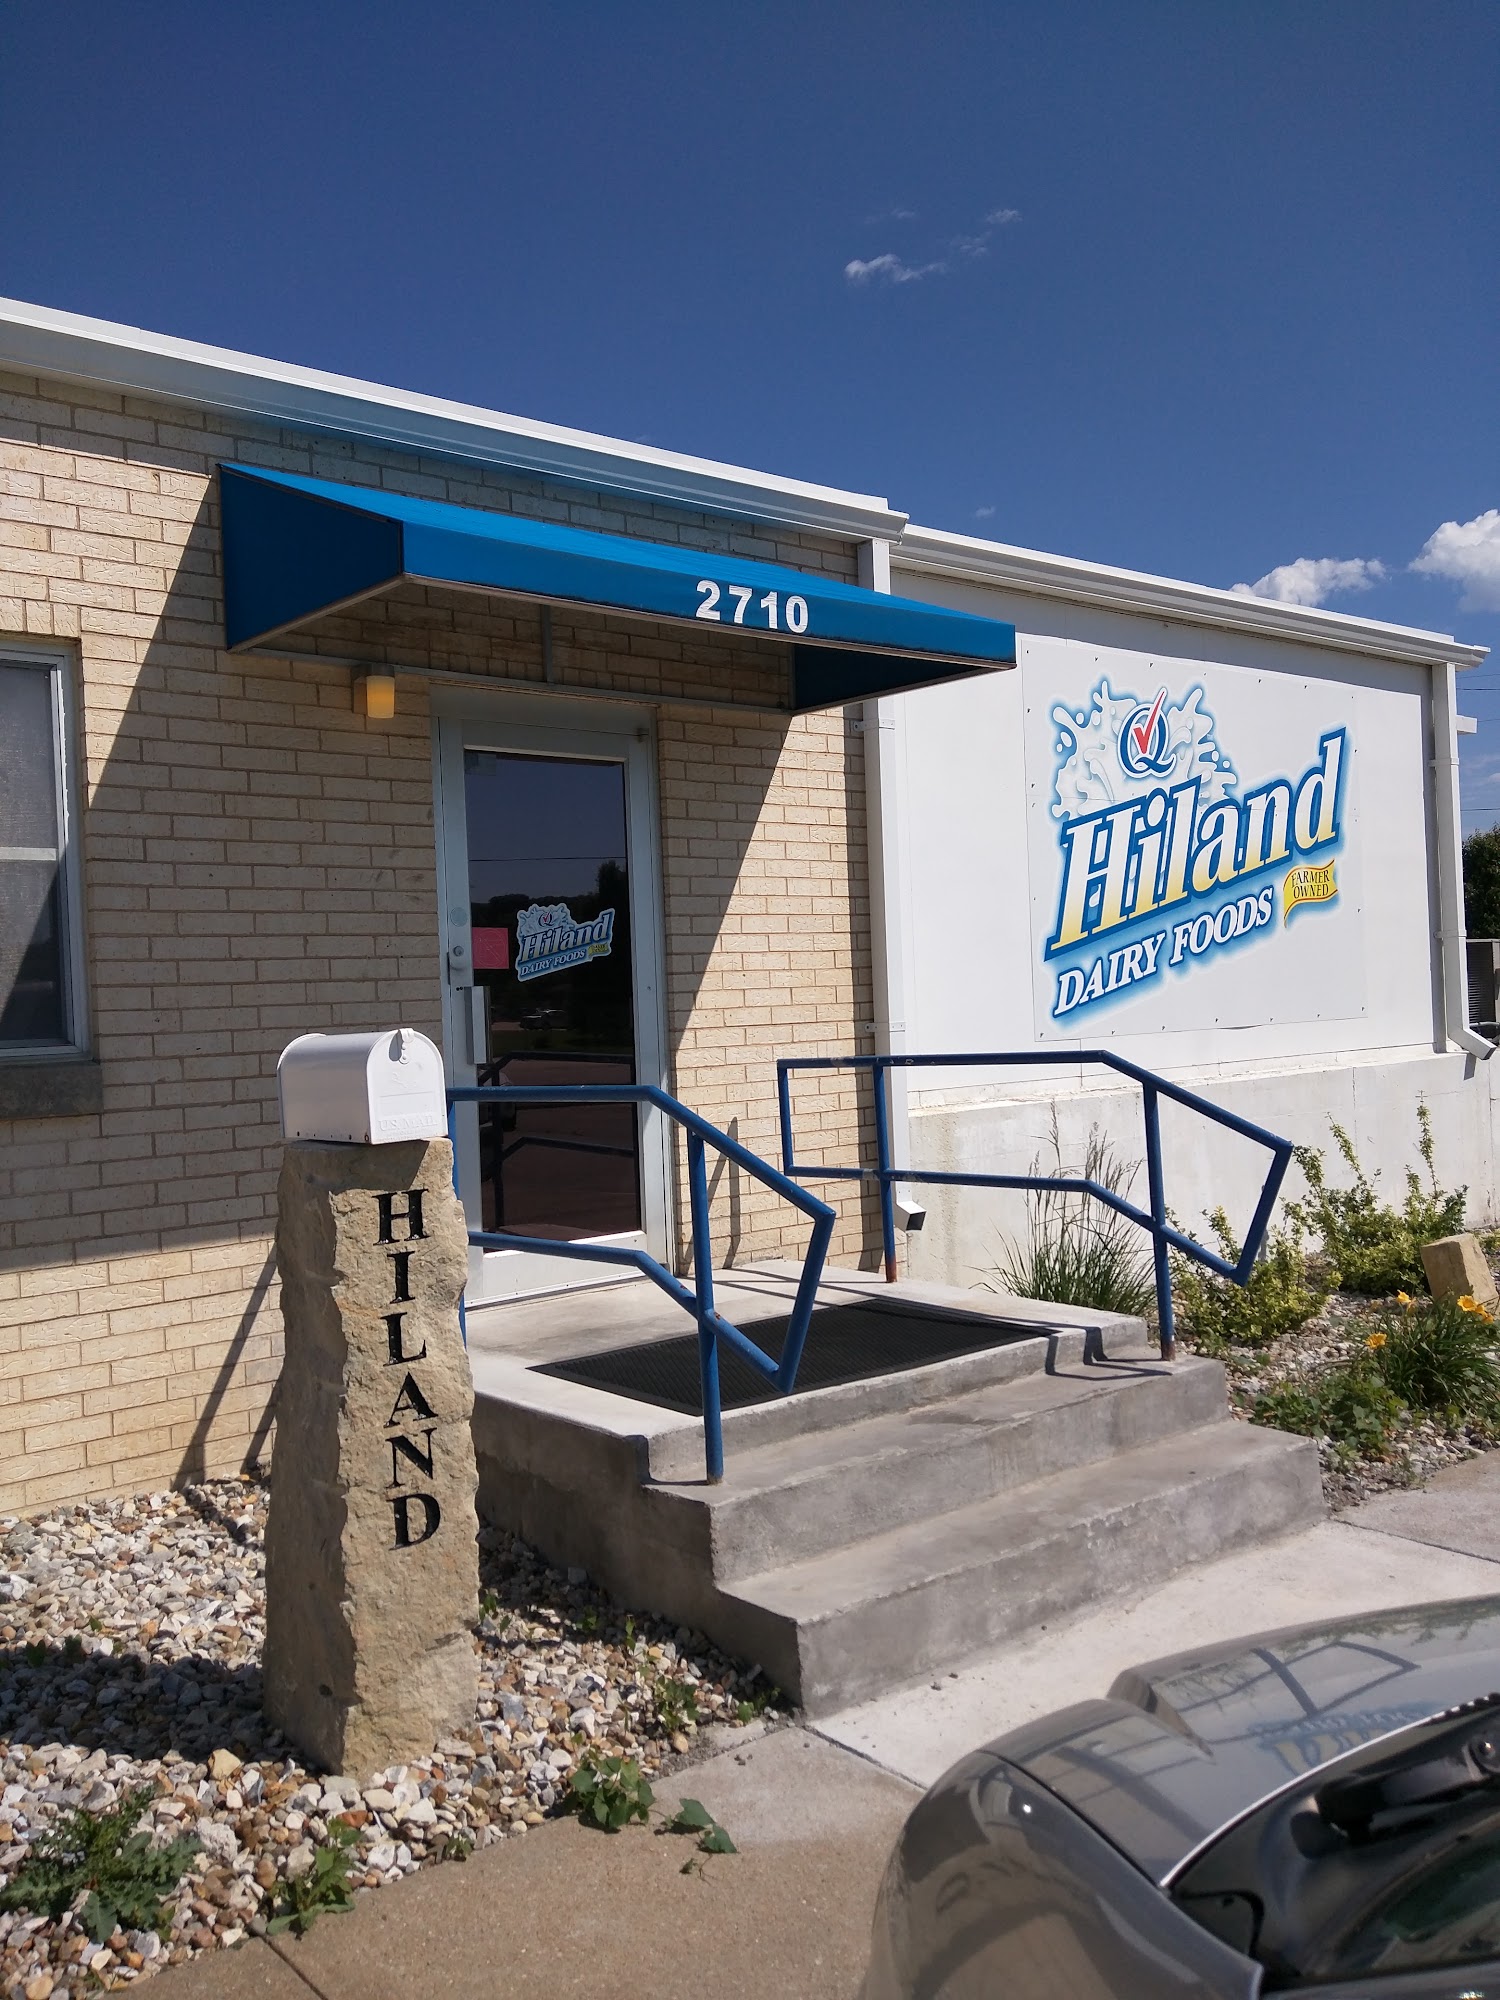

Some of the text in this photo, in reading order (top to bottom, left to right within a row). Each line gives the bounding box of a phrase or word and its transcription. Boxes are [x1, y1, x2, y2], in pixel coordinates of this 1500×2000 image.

[695, 579, 809, 634] 2710
[1047, 730, 1345, 957] Hiland
[1291, 869, 1330, 888] FARMER
[1293, 884, 1329, 899] OWNED
[520, 912, 611, 963] Hiland
[520, 949, 586, 976] DAIRY FOODS
[1054, 887, 1274, 1017] DAIRY FOODS
[372, 1188, 441, 1551] HILAND
